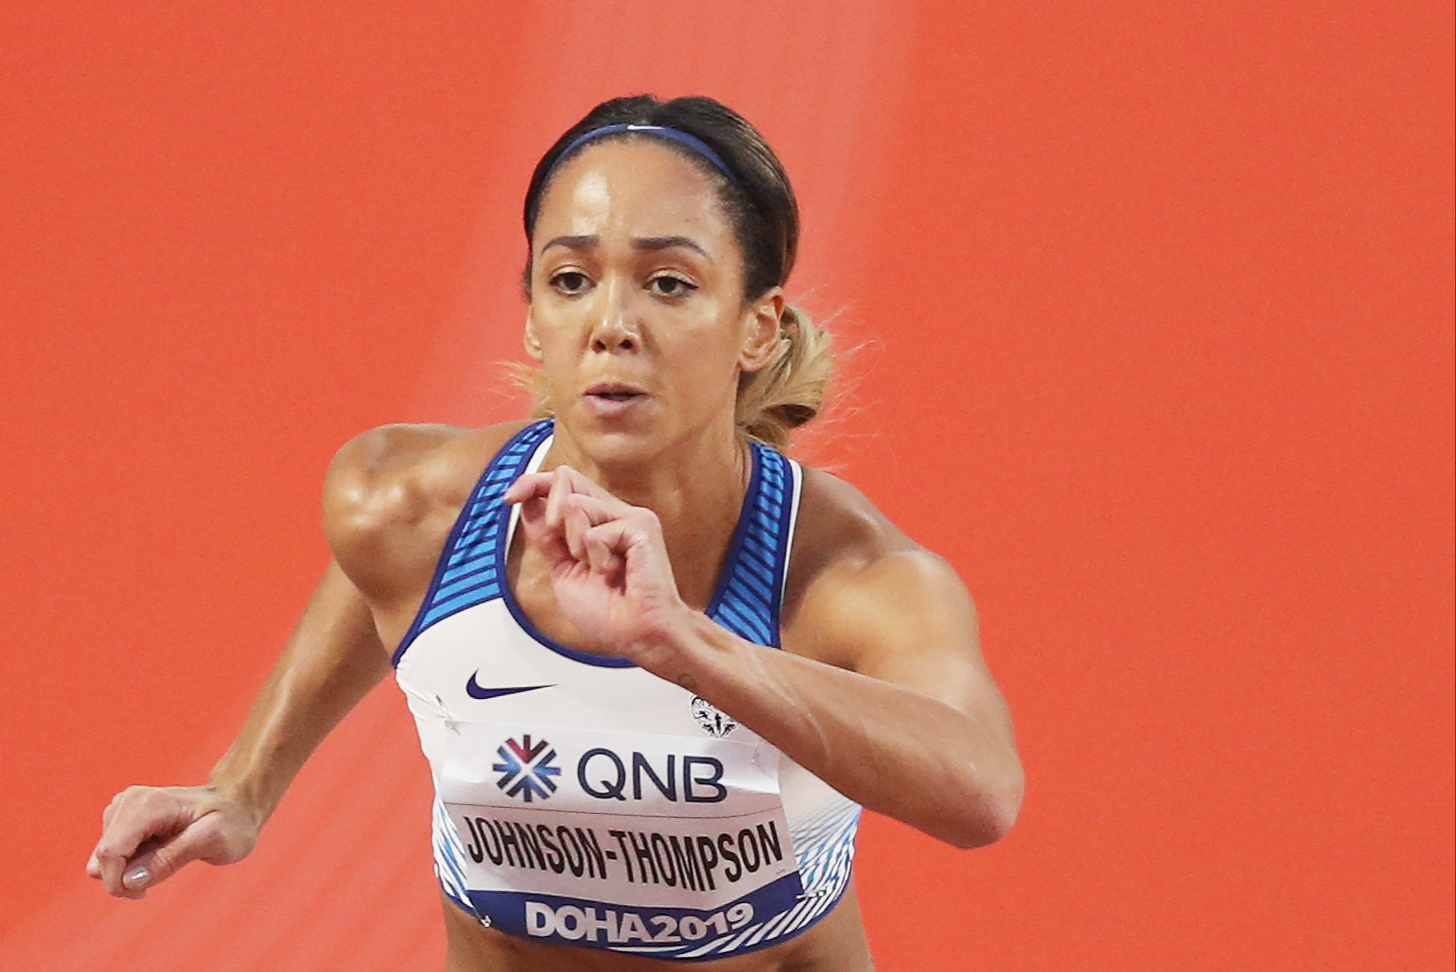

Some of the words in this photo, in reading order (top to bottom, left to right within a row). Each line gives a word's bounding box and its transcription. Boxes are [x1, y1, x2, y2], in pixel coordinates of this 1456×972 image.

[577, 747, 728, 804] QNB
[462, 815, 784, 892] JOHNSON-THOMPSON
[525, 901, 755, 944] DOHA2019
